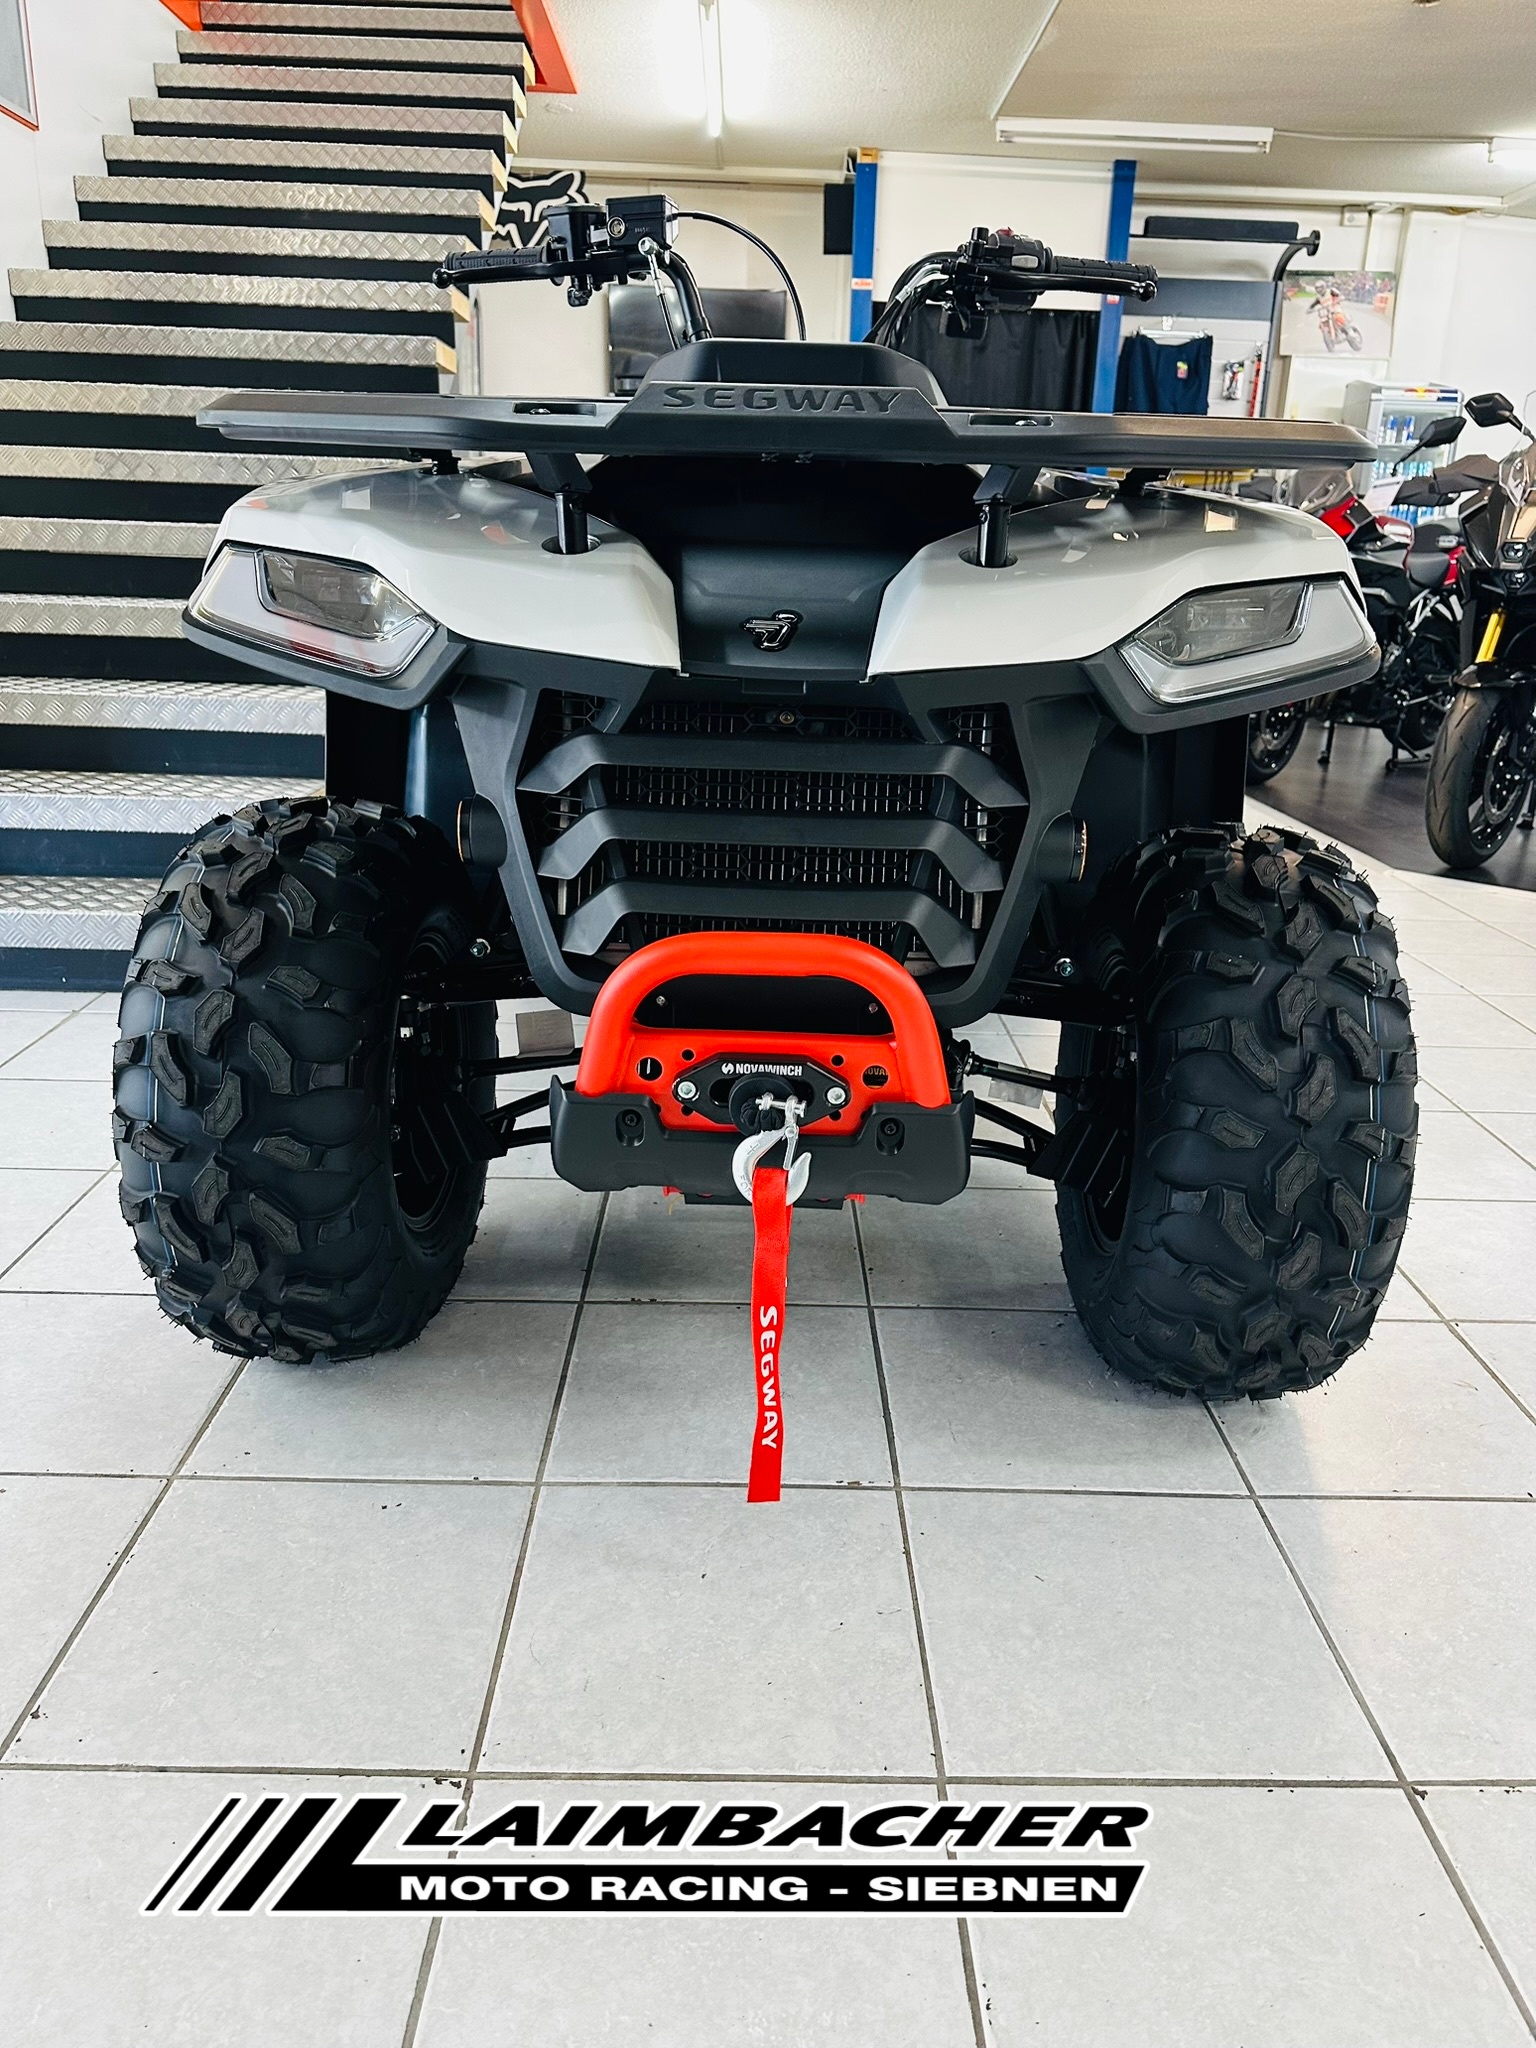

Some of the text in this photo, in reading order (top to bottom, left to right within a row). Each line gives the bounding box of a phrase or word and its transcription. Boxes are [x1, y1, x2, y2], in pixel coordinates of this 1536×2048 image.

[663, 387, 901, 414] SEGWAY
[736, 1063, 802, 1076] NOVAWINCH
[760, 1306, 778, 1449] SEGWAY
